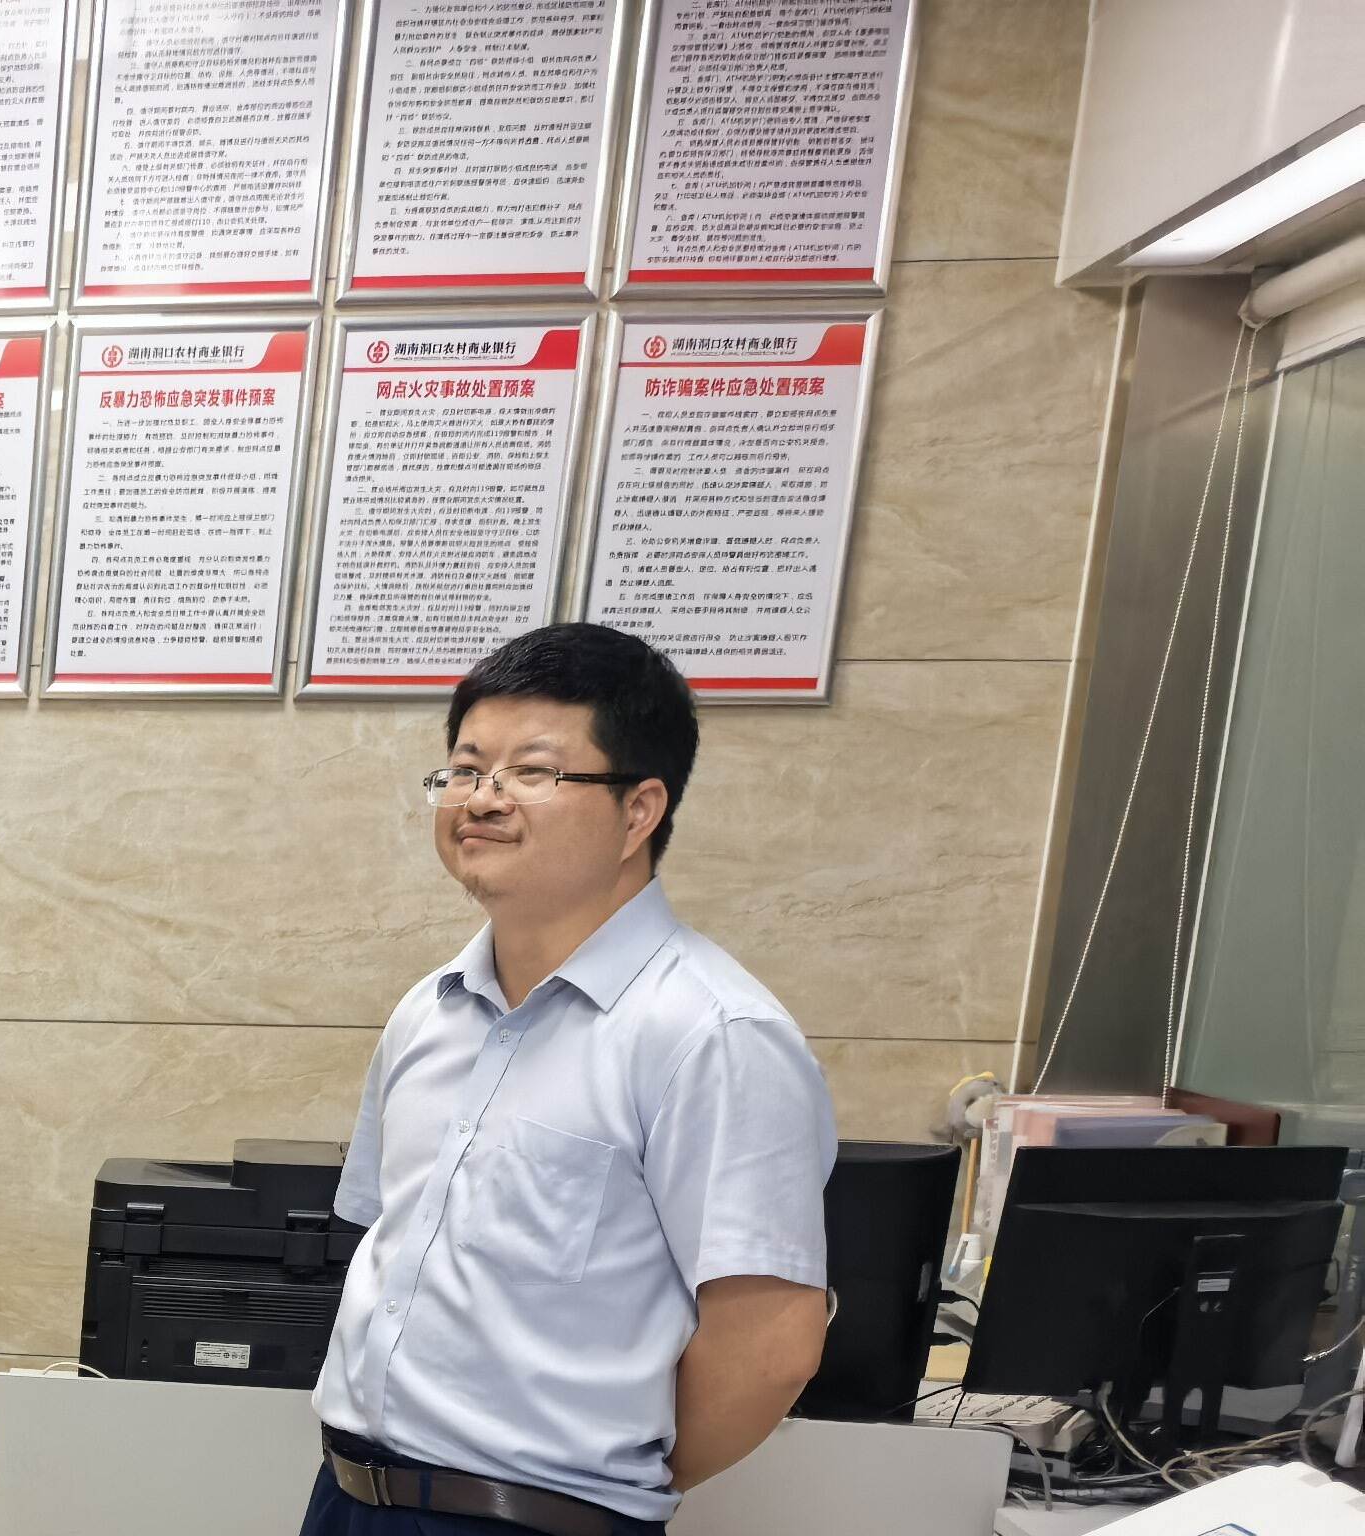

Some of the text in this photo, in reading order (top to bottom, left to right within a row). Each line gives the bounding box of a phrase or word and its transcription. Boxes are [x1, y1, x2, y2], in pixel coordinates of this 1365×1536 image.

[128, 345, 245, 360] 湖南洞口农村商业银行
[394, 341, 516, 356] 湖南洞口农村商业银行
[672, 336, 798, 351] 湖南洞口农村商业银行
[376, 378, 536, 400] 网点火灾事故处置预案
[644, 375, 825, 397] 防诈骗案件应急处置预案
[99, 387, 276, 409] 反暴力恐怖应急突发事件预案
